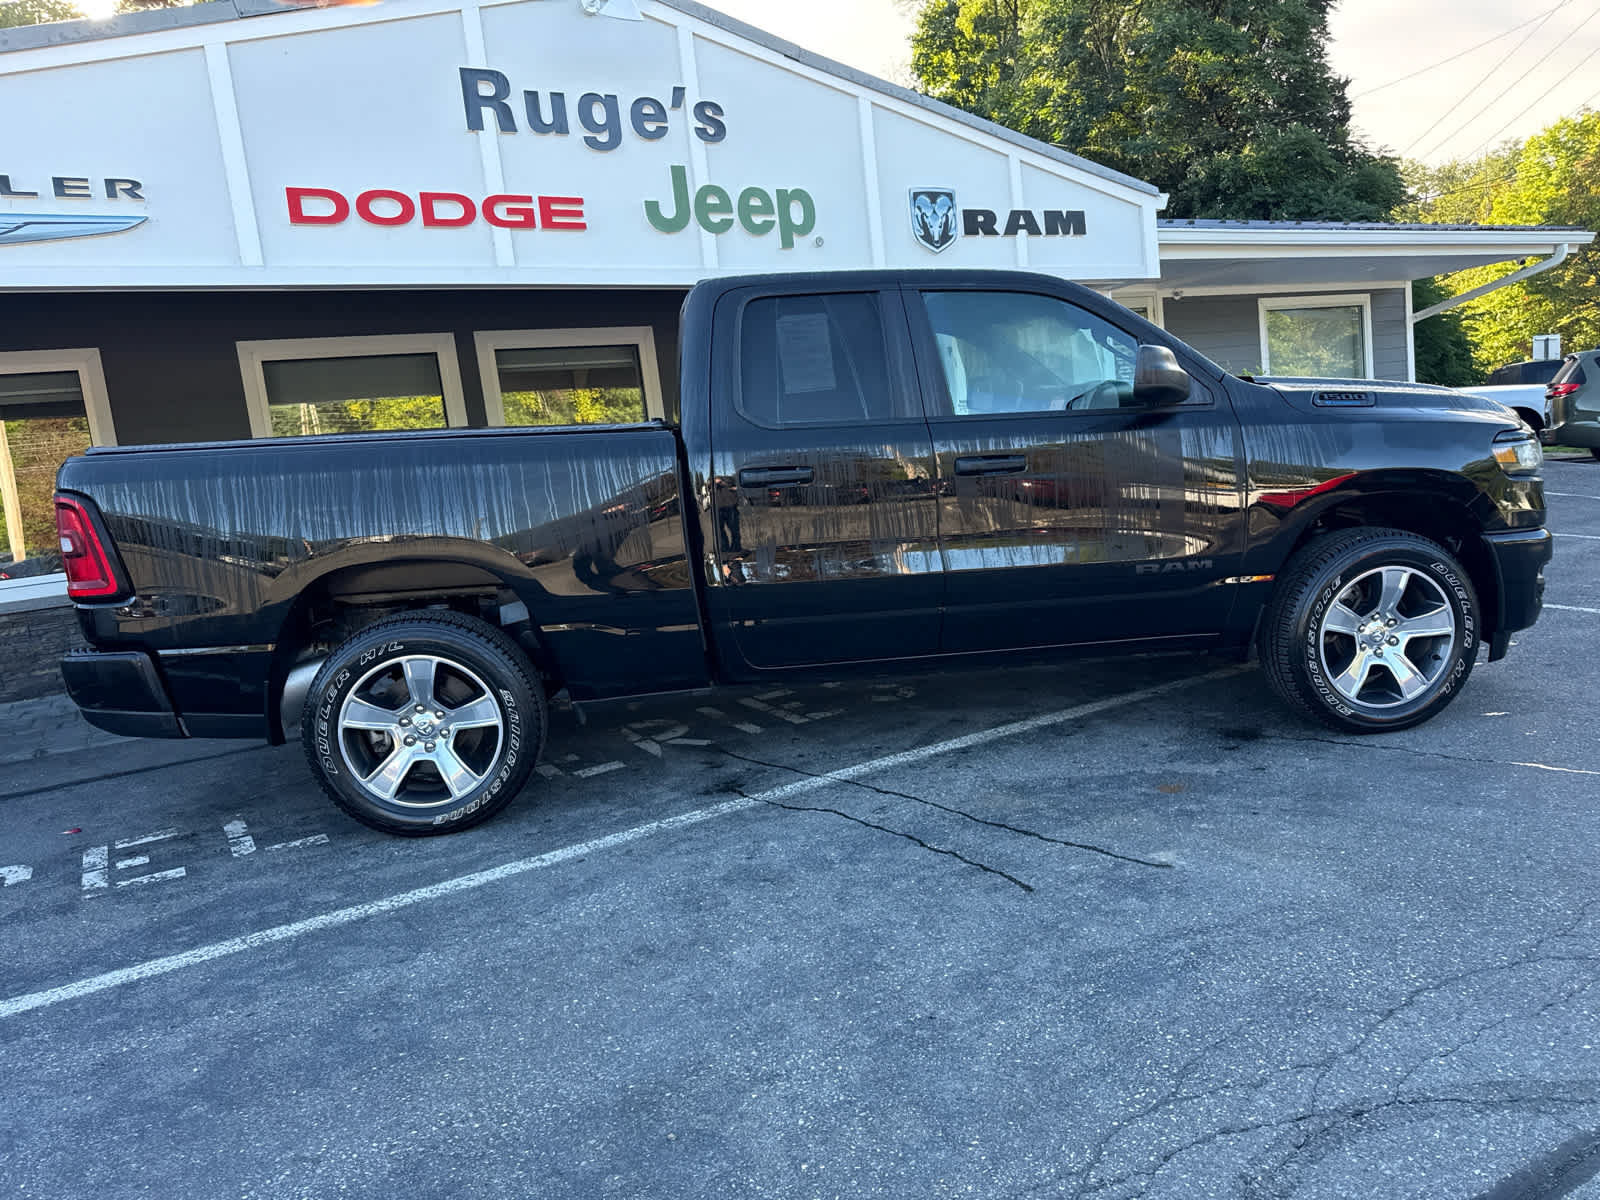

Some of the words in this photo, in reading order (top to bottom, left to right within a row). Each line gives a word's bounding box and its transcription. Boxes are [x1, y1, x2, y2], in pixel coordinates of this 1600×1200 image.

[459, 67, 726, 150] Ruge's
[285, 187, 587, 230] DODGE
[644, 165, 816, 249] Jeep
[962, 209, 1087, 236] RAM
[1136, 560, 1213, 577] RAM
[1430, 562, 1473, 648] DUELER
[1307, 576, 1354, 716] BRIDGESTONE
[319, 669, 350, 774] DUELER
[360, 641, 404, 666] H/L
[432, 689, 521, 825] BRIDGESTONE
